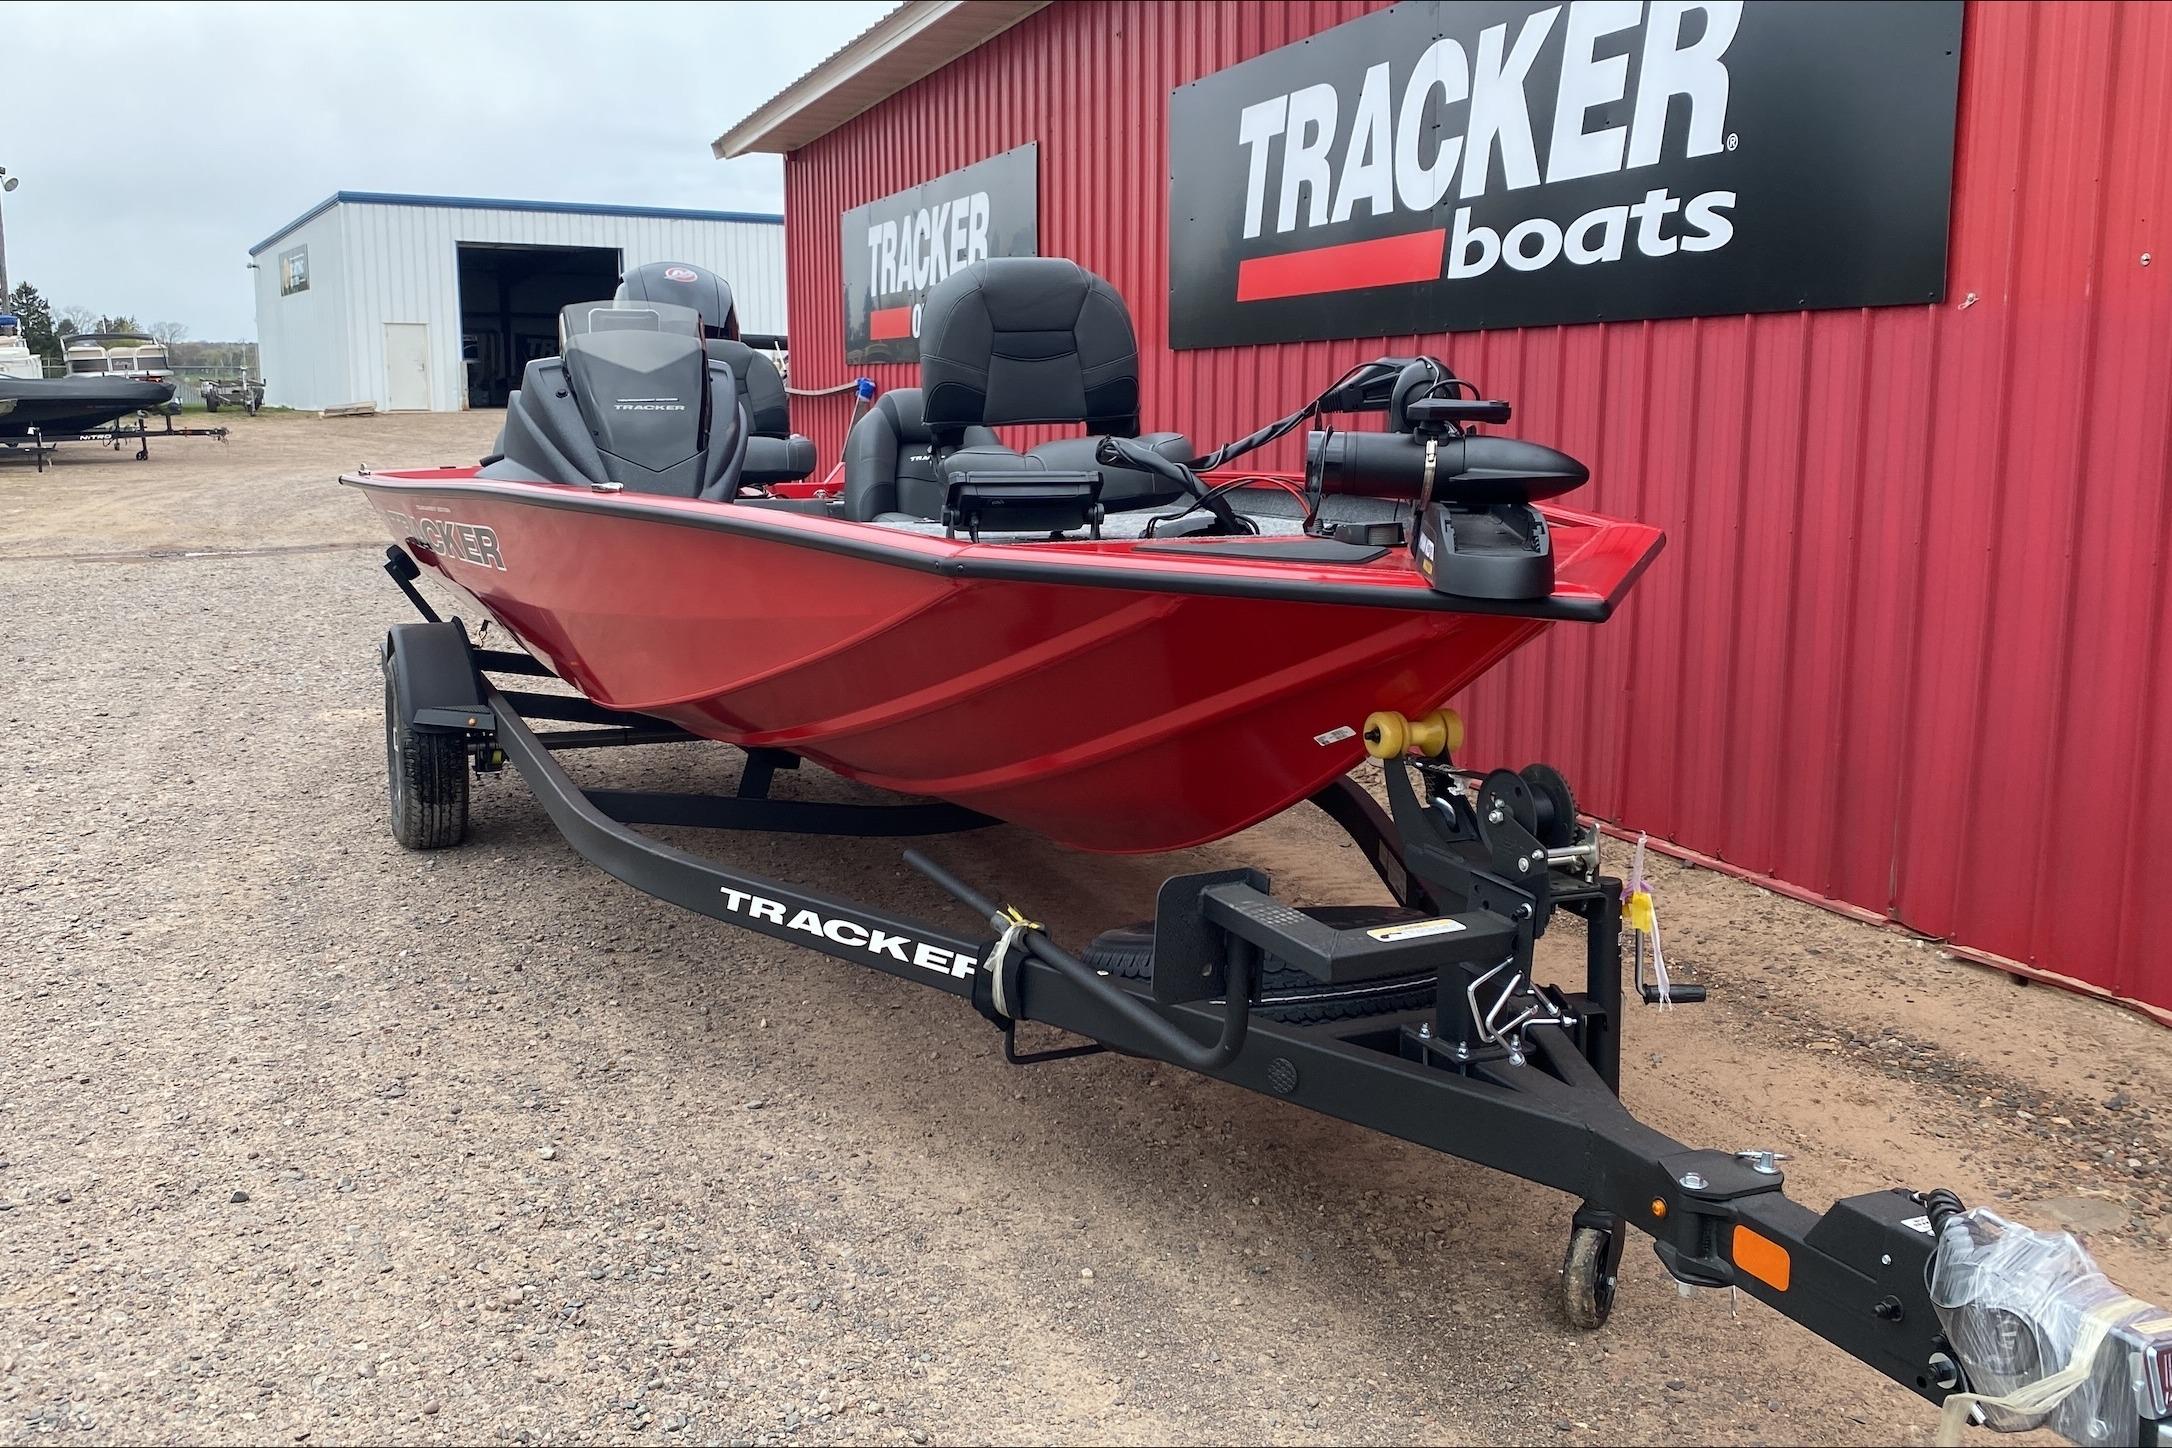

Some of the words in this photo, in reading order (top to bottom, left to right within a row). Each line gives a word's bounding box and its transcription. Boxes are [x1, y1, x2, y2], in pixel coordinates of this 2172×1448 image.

[868, 192, 990, 297] TRACKER
[1447, 187, 1737, 279] boats
[385, 509, 507, 571] CKER
